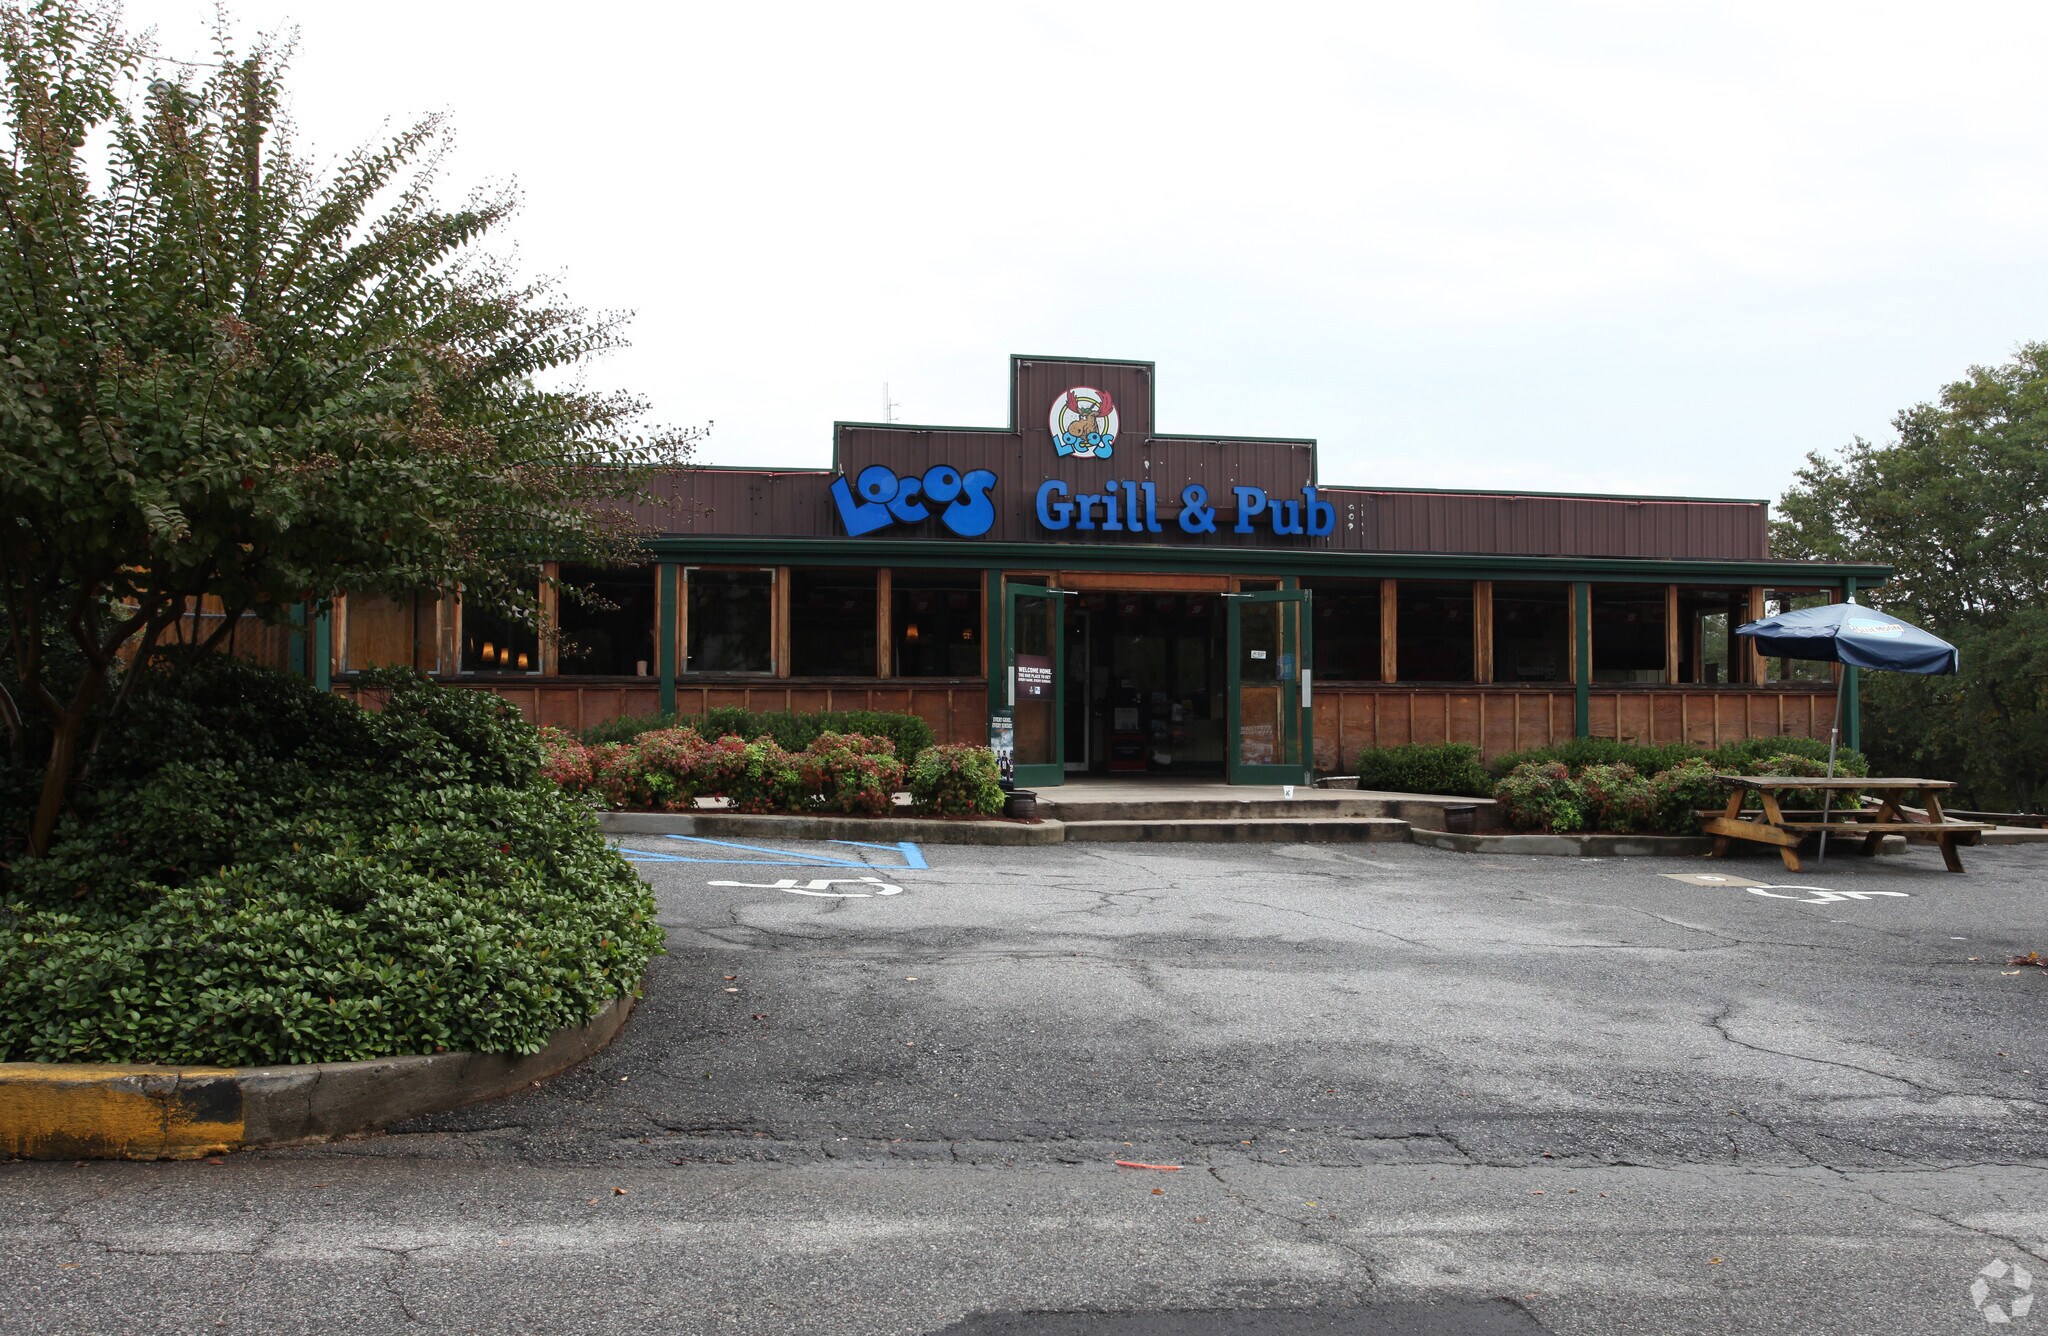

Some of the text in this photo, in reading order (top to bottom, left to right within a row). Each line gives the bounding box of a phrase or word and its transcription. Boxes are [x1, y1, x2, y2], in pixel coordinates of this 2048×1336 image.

[1036, 479, 1336, 536] Grill & Pub
